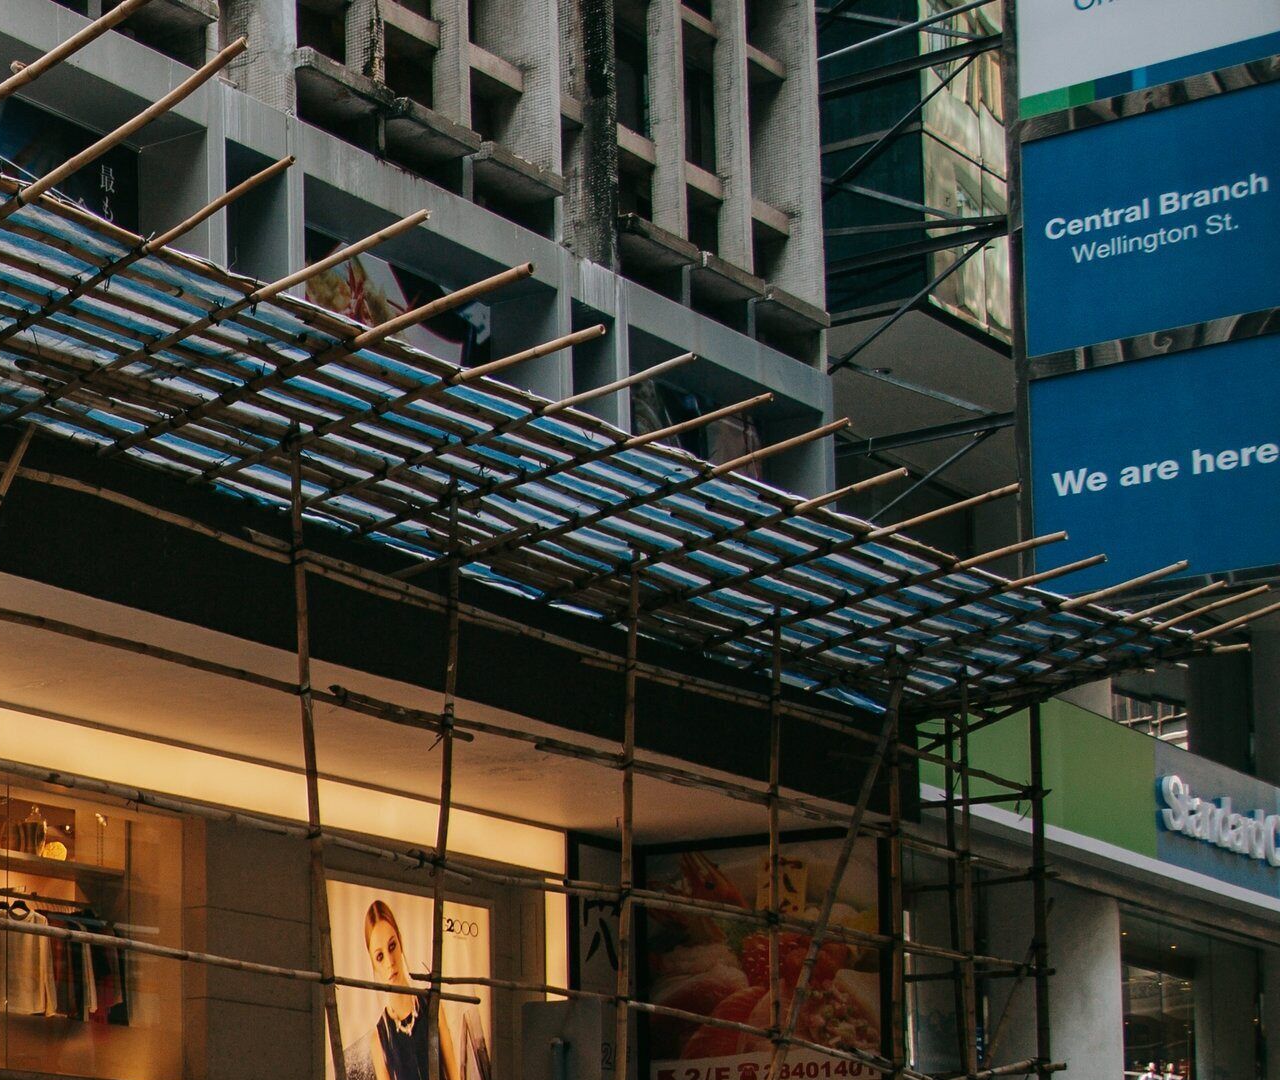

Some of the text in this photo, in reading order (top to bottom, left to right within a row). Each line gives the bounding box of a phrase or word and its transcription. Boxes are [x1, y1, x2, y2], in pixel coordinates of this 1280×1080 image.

[1045, 173, 1269, 241] Central Branch
[1071, 211, 1239, 265] Wellington St.
[1052, 441, 1279, 498] We are here
[1161, 773, 1265, 860] Standard
